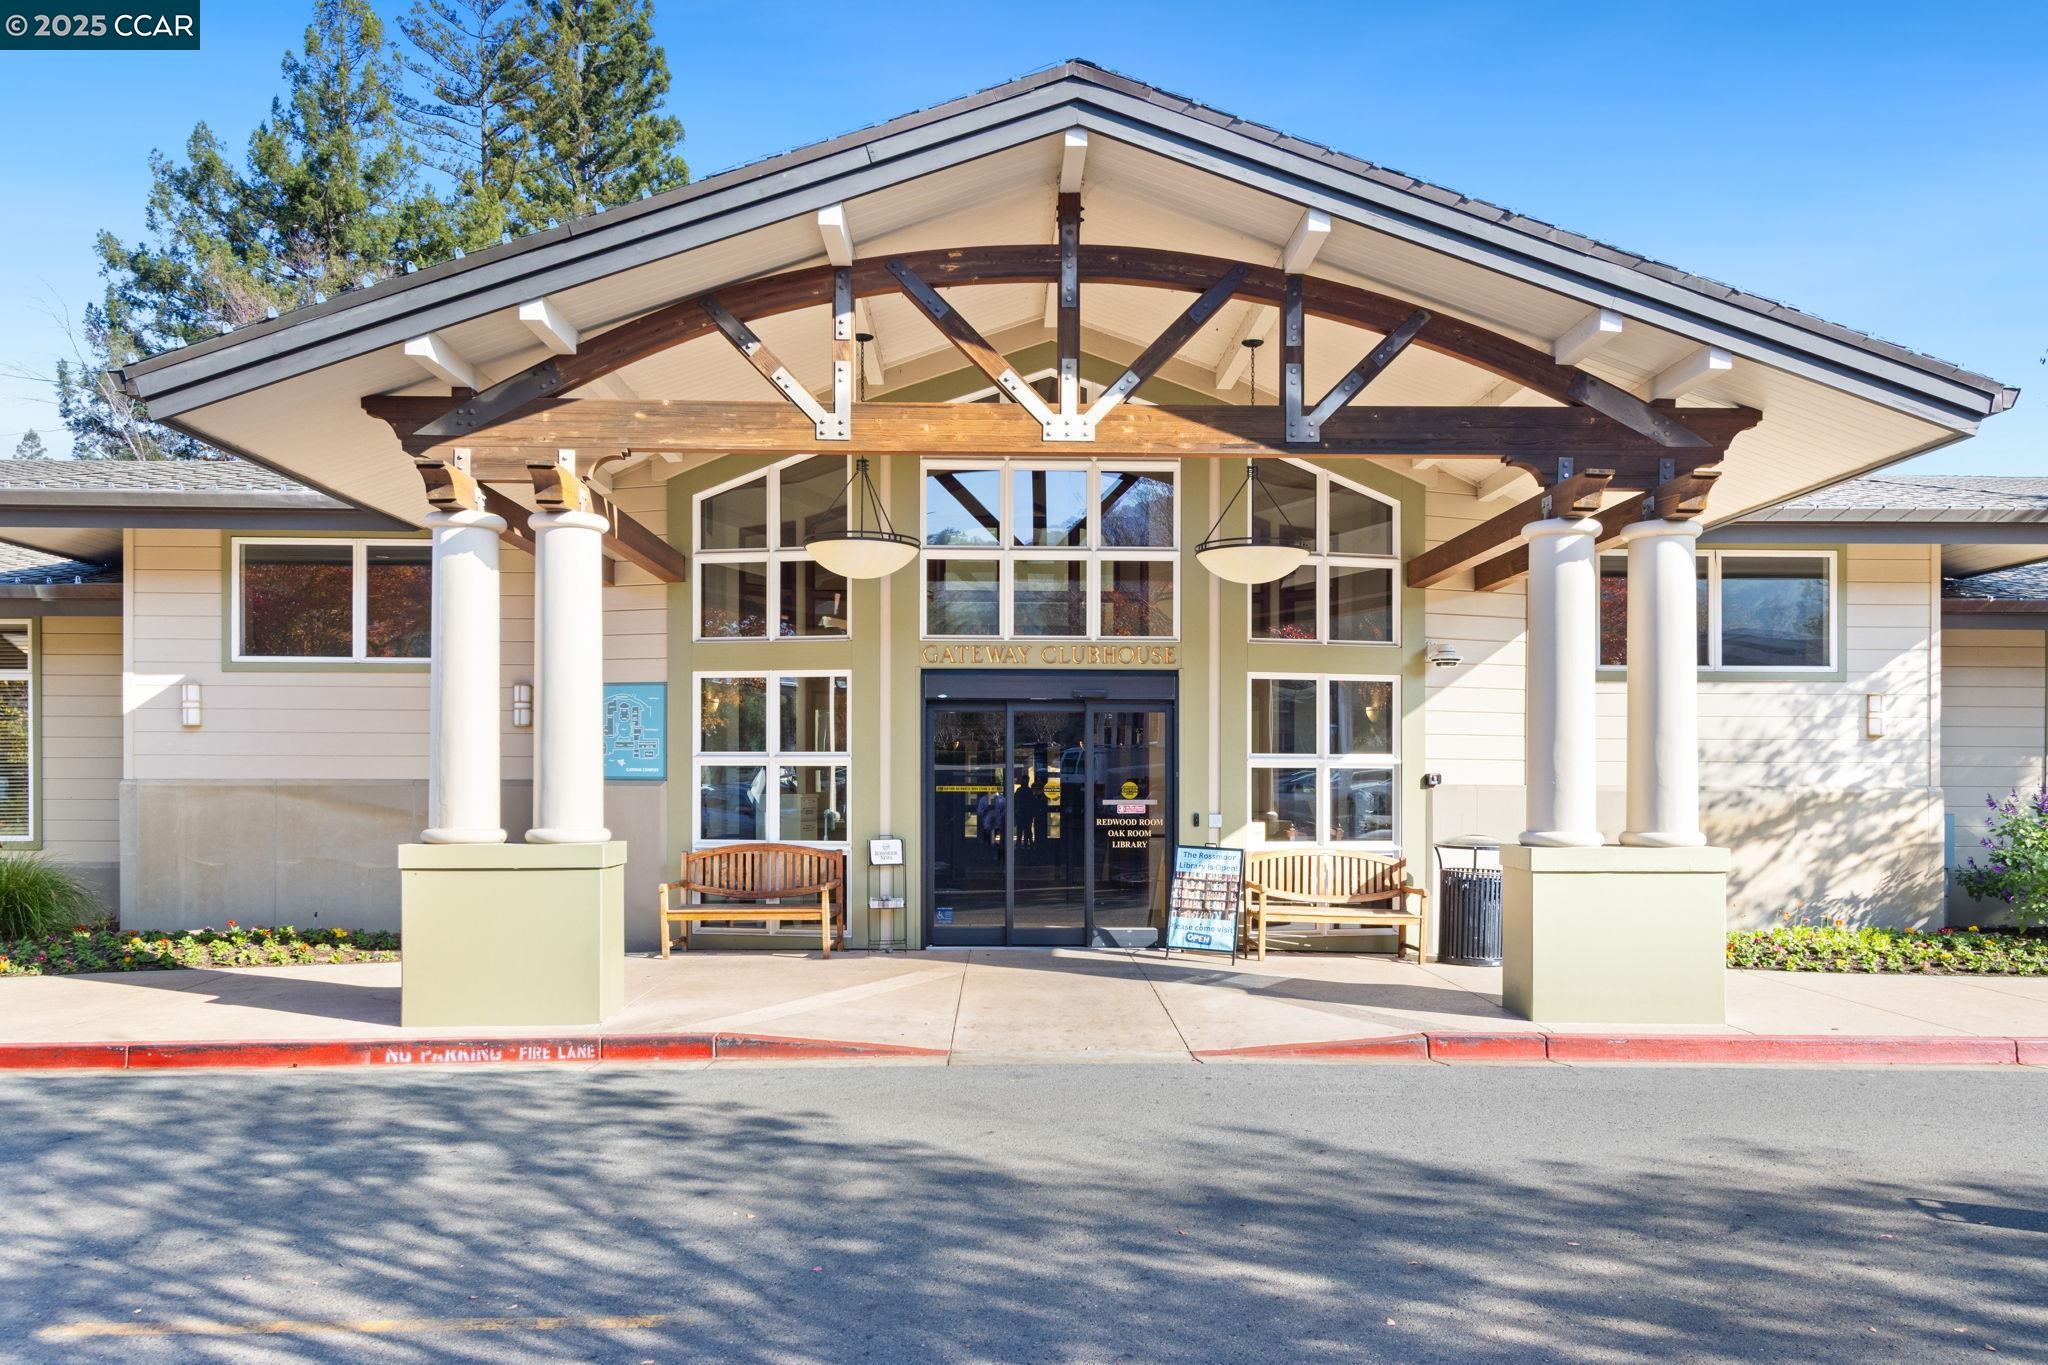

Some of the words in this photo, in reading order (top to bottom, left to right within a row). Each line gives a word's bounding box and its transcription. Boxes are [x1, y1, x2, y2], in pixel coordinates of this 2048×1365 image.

[921, 645, 1032, 665] GATEWAY
[1040, 645, 1177, 665] CLUBHOUSE
[1096, 818, 1137, 826] REDWOOD
[1139, 818, 1164, 826] ROOM
[1107, 829, 1126, 837] OAK
[1127, 829, 1152, 838] ROOM
[1112, 841, 1148, 849] LIBRARY
[1183, 851, 1197, 859] The
[1198, 852, 1236, 861] Rossmoor
[1179, 862, 1206, 871] Library
[1207, 862, 1215, 870] is
[1216, 925, 1233, 934] visit
[1187, 933, 1210, 943] OPEN
[385, 1048, 412, 1062] NO
[518, 1046, 551, 1060] FIRE
[558, 1045, 596, 1059] LANE
